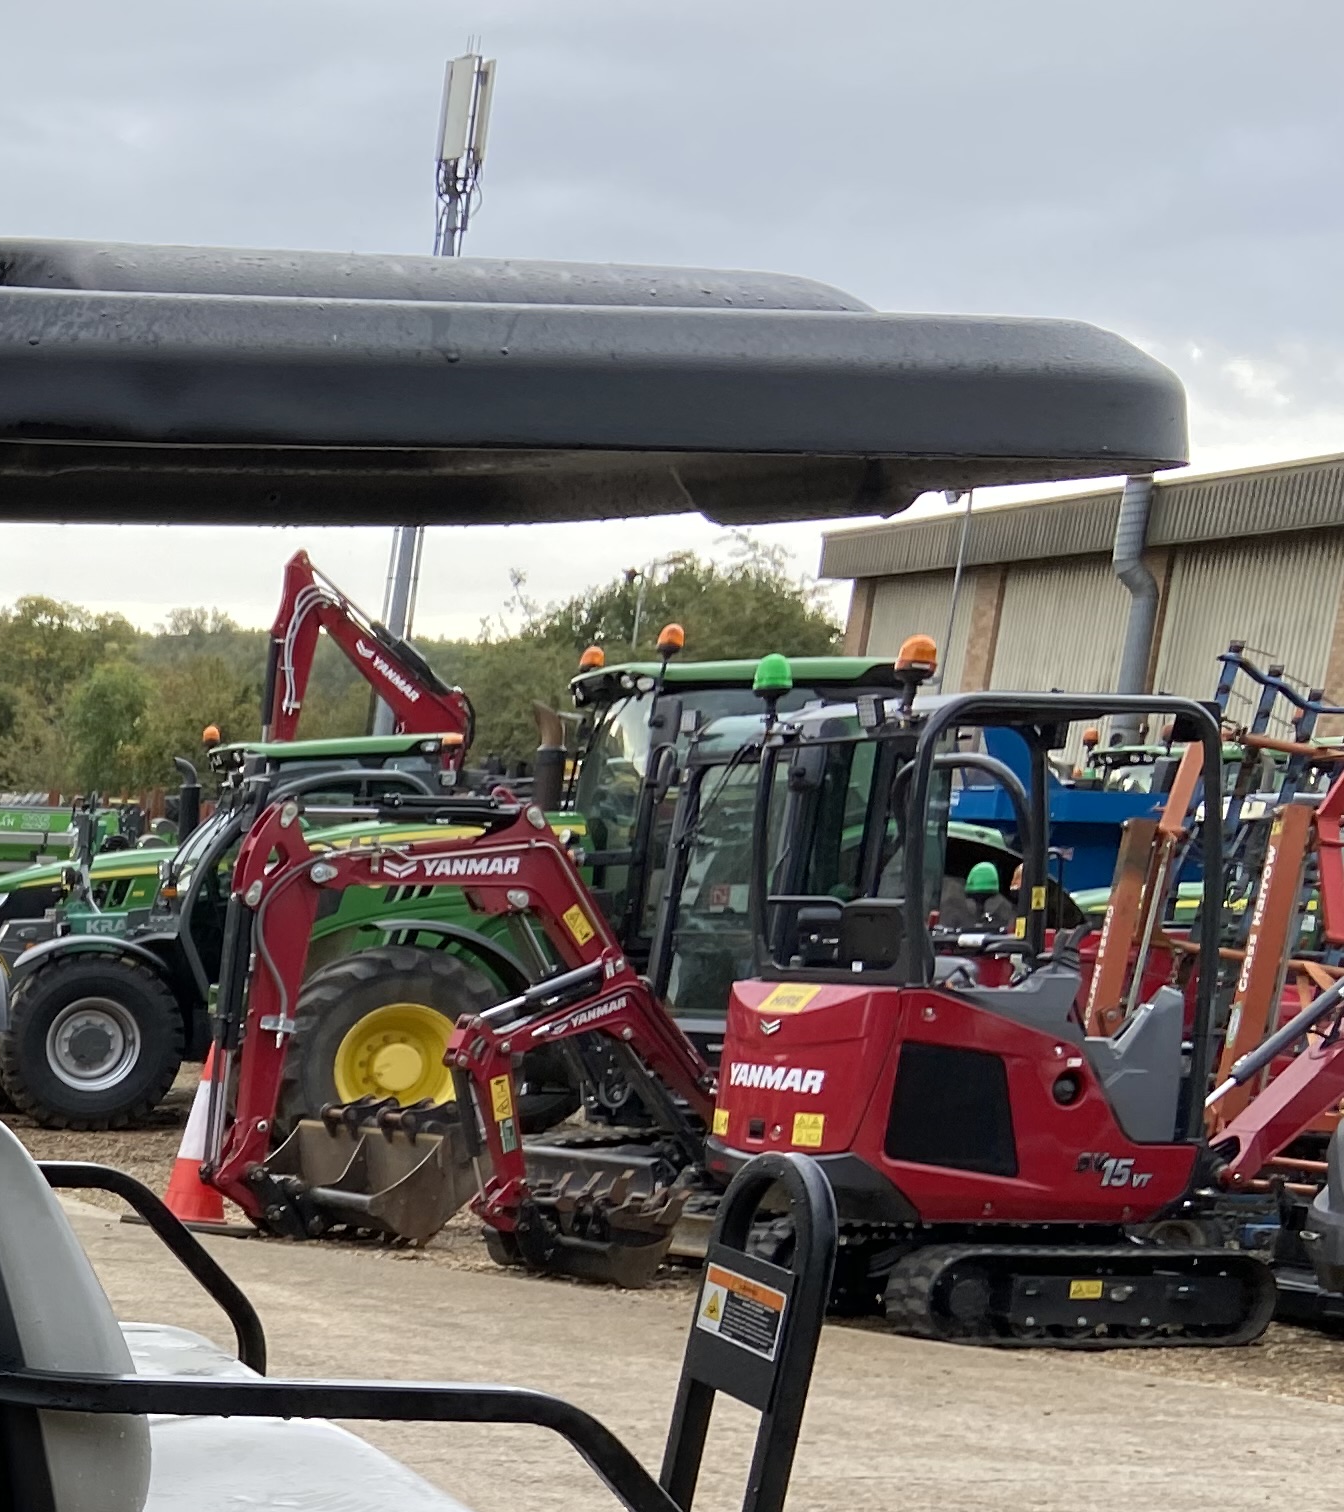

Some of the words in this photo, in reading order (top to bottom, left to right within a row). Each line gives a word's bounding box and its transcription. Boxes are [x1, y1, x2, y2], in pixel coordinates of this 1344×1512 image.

[373, 655, 419, 702] YANMAR
[423, 857, 520, 876] YANMAR
[1238, 934, 1259, 992] Grass
[1252, 844, 1278, 927] Harrow
[571, 997, 628, 1028] YANMAR
[730, 1062, 825, 1094] YANMAR
